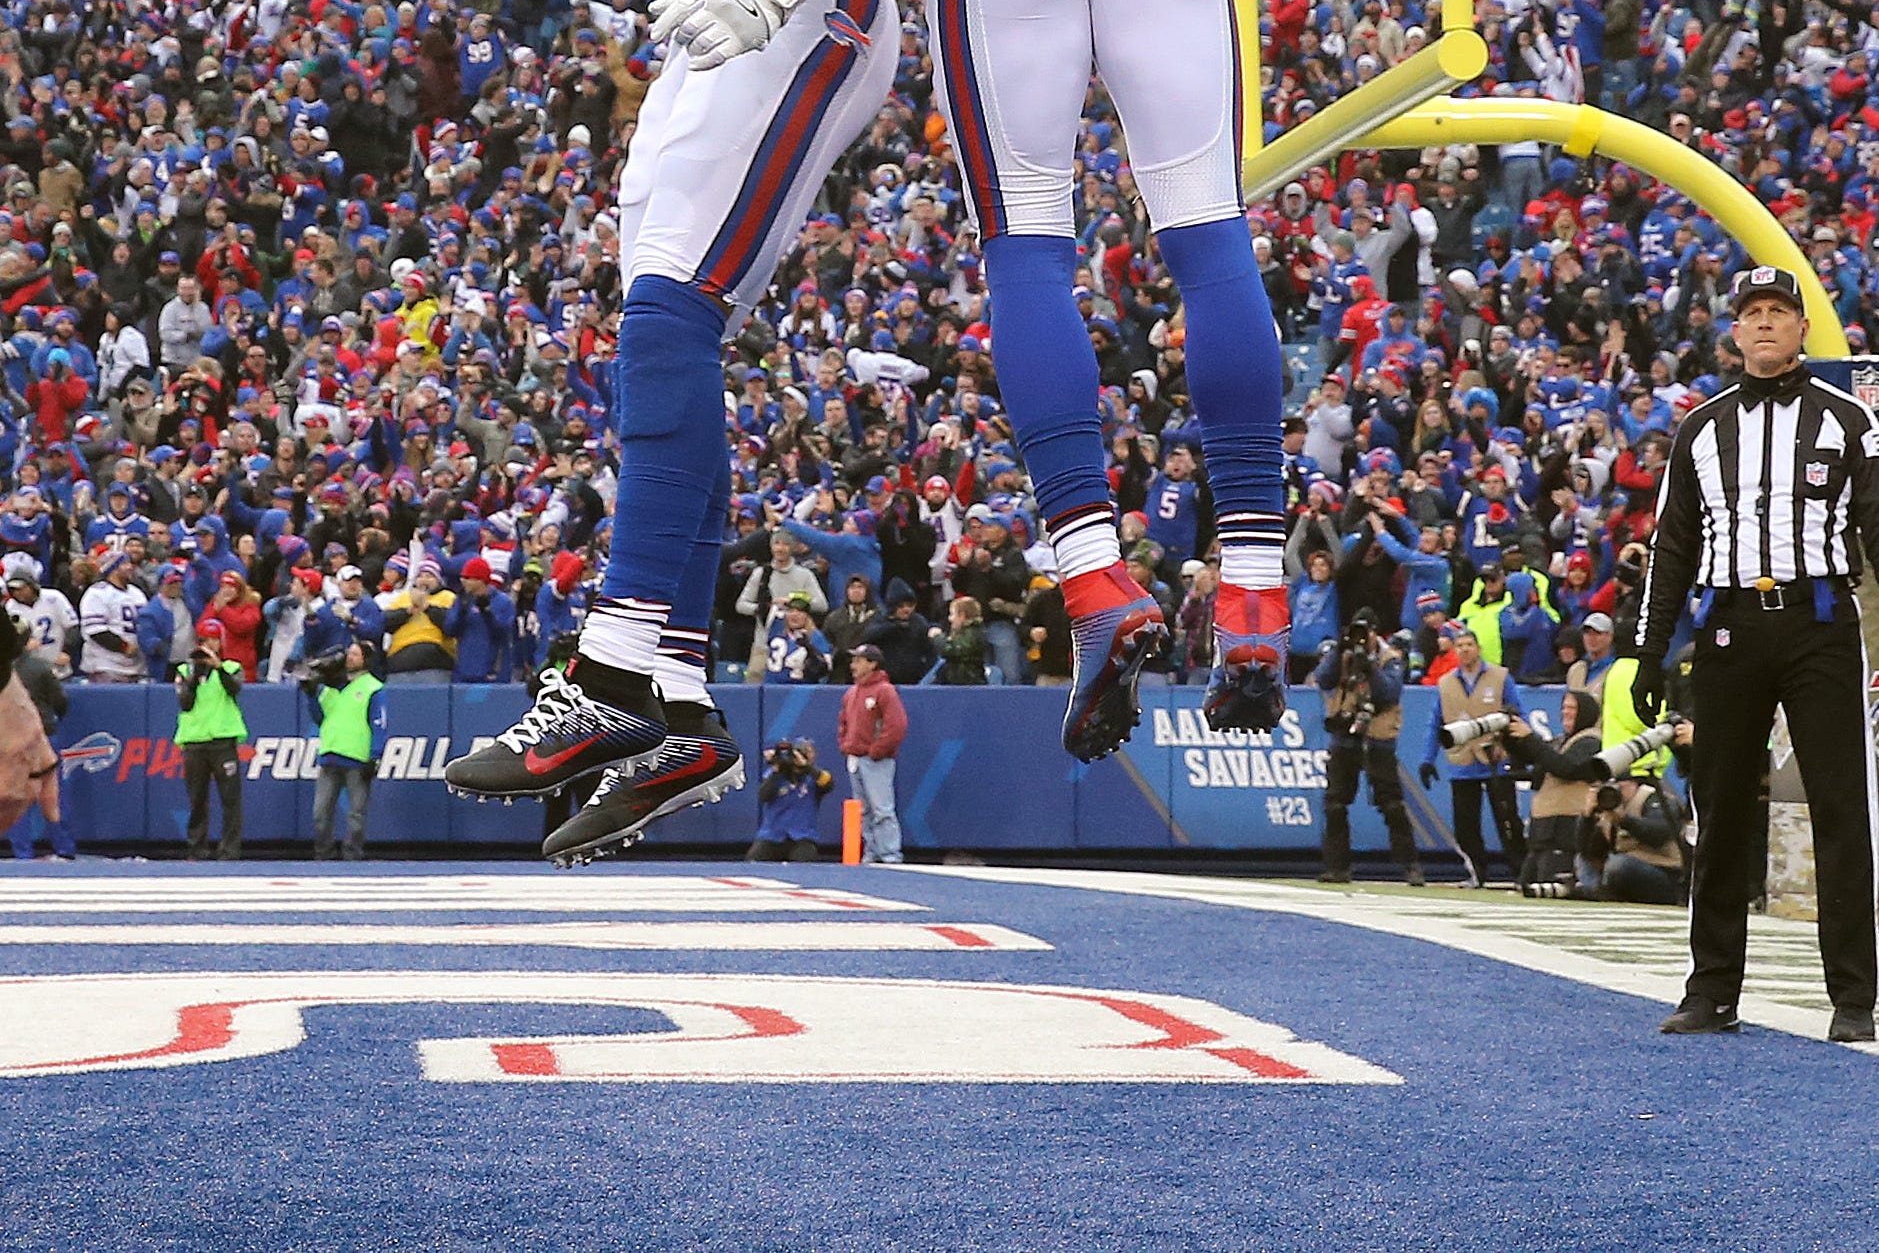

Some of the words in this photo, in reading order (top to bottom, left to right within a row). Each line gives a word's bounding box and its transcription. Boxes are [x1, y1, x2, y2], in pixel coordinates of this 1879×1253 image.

[155, 159, 170, 184] 4
[1158, 490, 1180, 519] 5
[37, 616, 56, 645] 2
[766, 636, 808, 680] 34
[246, 736, 450, 780] FOOALL
[1184, 748, 1331, 789] SAVAGES
[1266, 796, 1313, 826] #23
